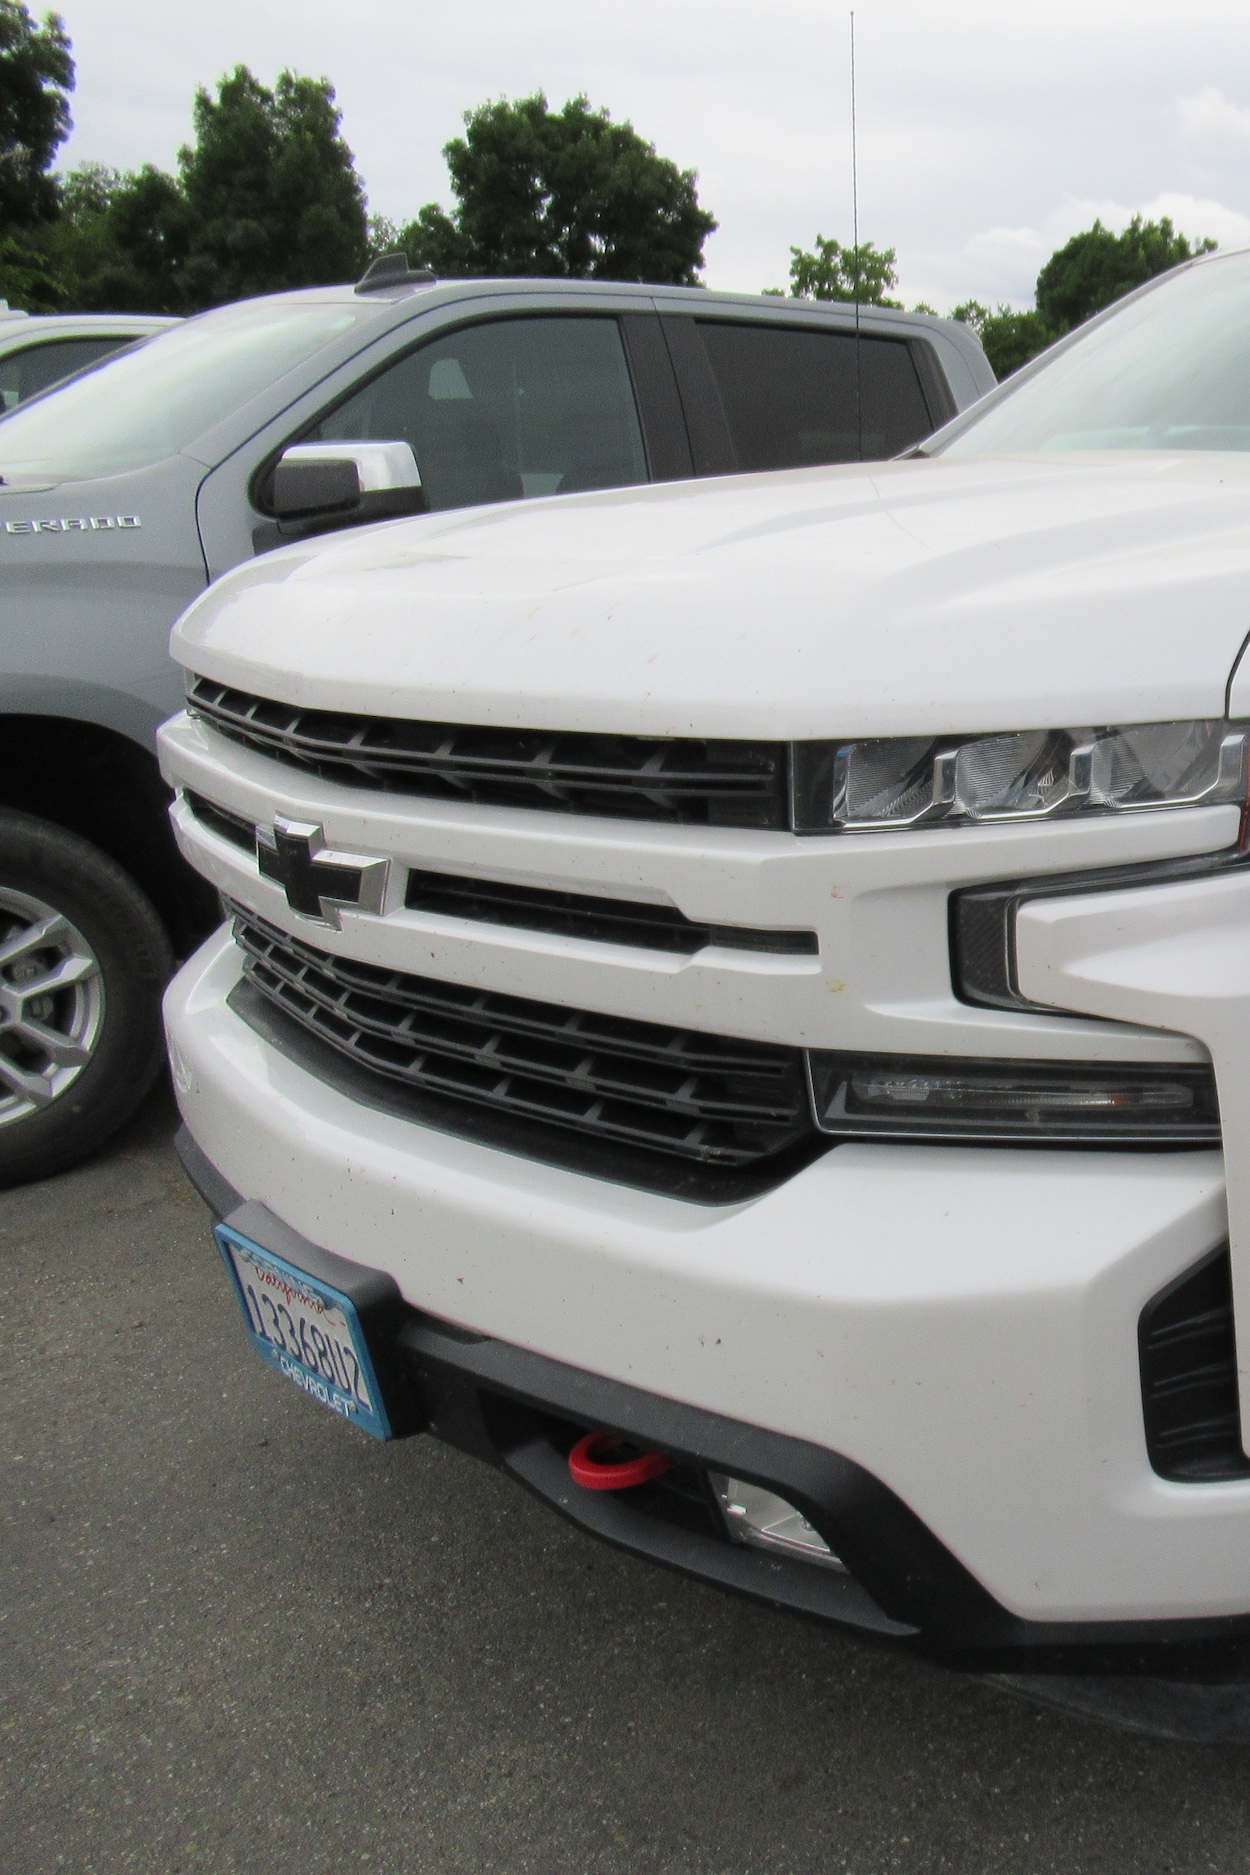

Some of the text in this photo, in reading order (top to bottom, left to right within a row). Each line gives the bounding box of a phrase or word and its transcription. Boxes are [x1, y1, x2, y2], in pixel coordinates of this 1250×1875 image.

[0, 515, 142, 534] ERADO
[247, 1284, 371, 1410] 13368U2
[280, 1357, 354, 1416] CHEVROLET
